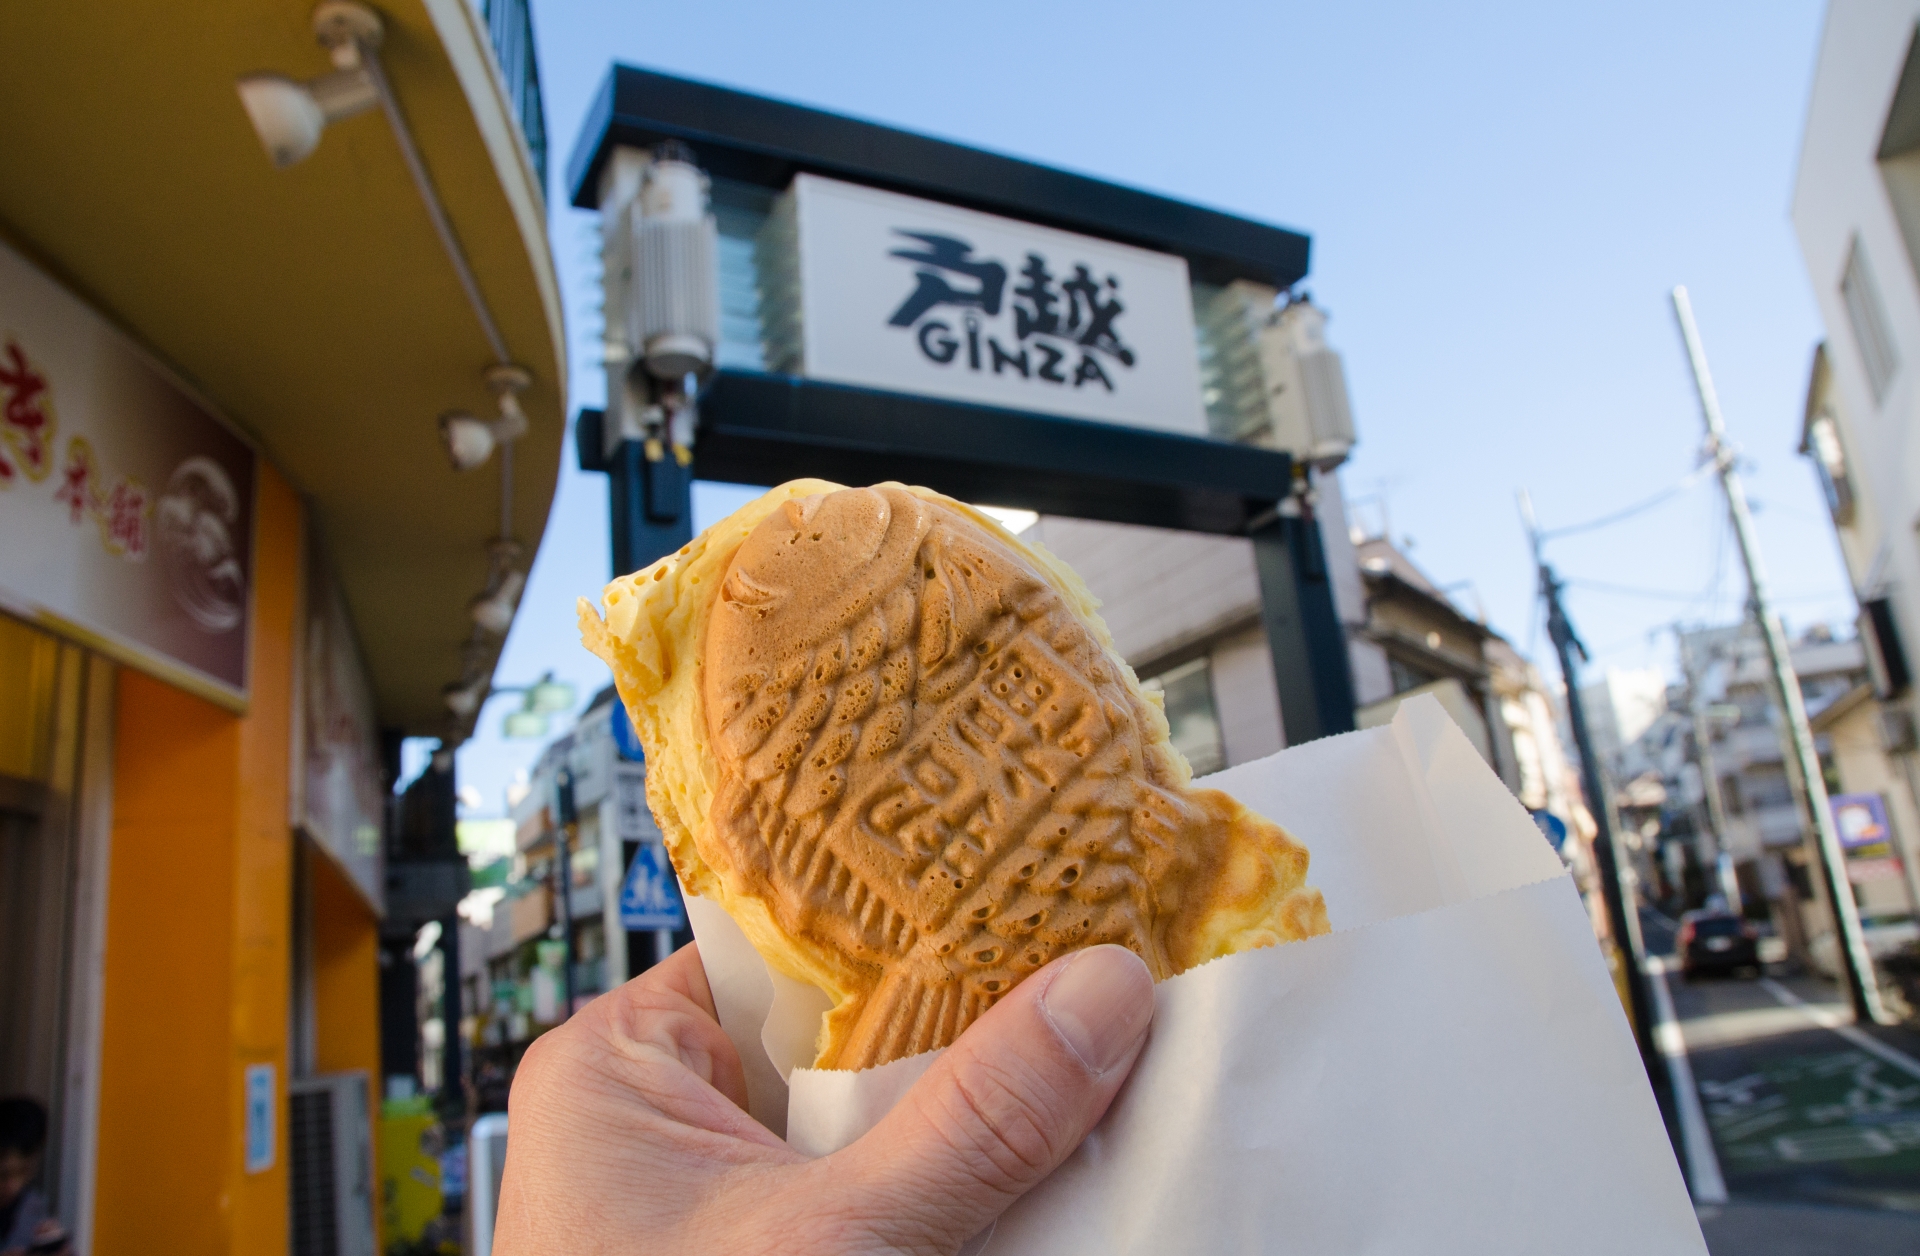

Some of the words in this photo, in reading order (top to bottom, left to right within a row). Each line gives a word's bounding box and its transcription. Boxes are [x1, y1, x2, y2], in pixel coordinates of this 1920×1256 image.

[888, 227, 1136, 368] 戸越
[917, 312, 1115, 393] GINZA
[0, 340, 148, 555] き本舗
